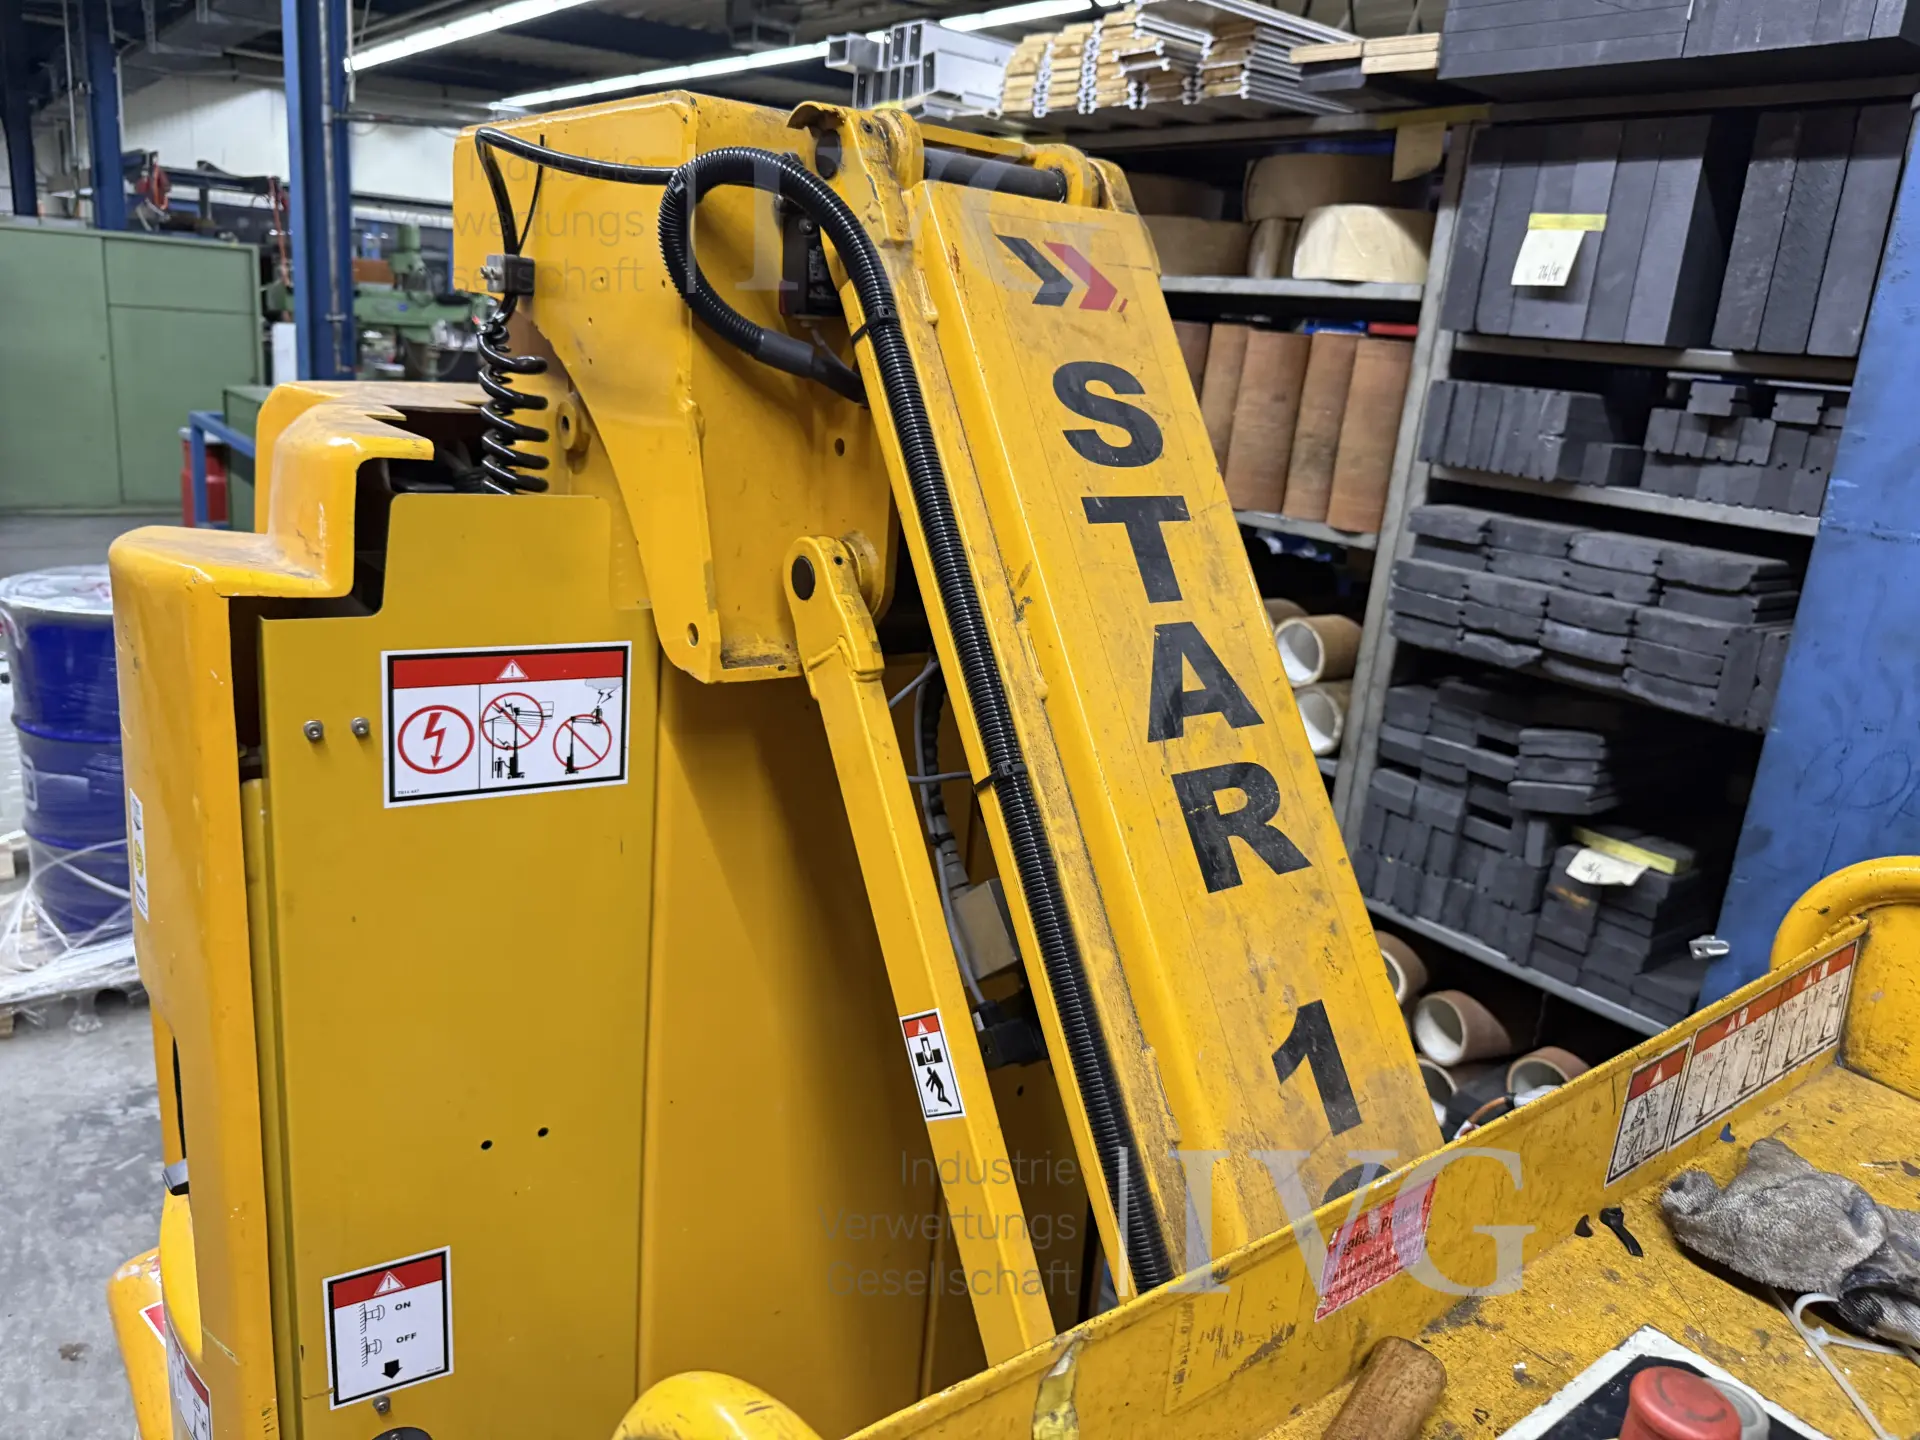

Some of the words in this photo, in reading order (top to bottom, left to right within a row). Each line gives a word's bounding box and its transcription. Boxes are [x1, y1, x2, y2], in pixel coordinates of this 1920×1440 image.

[1053, 361, 1312, 893] STAR
[394, 1301, 412, 1311] ON
[396, 1332, 417, 1344] OFF
